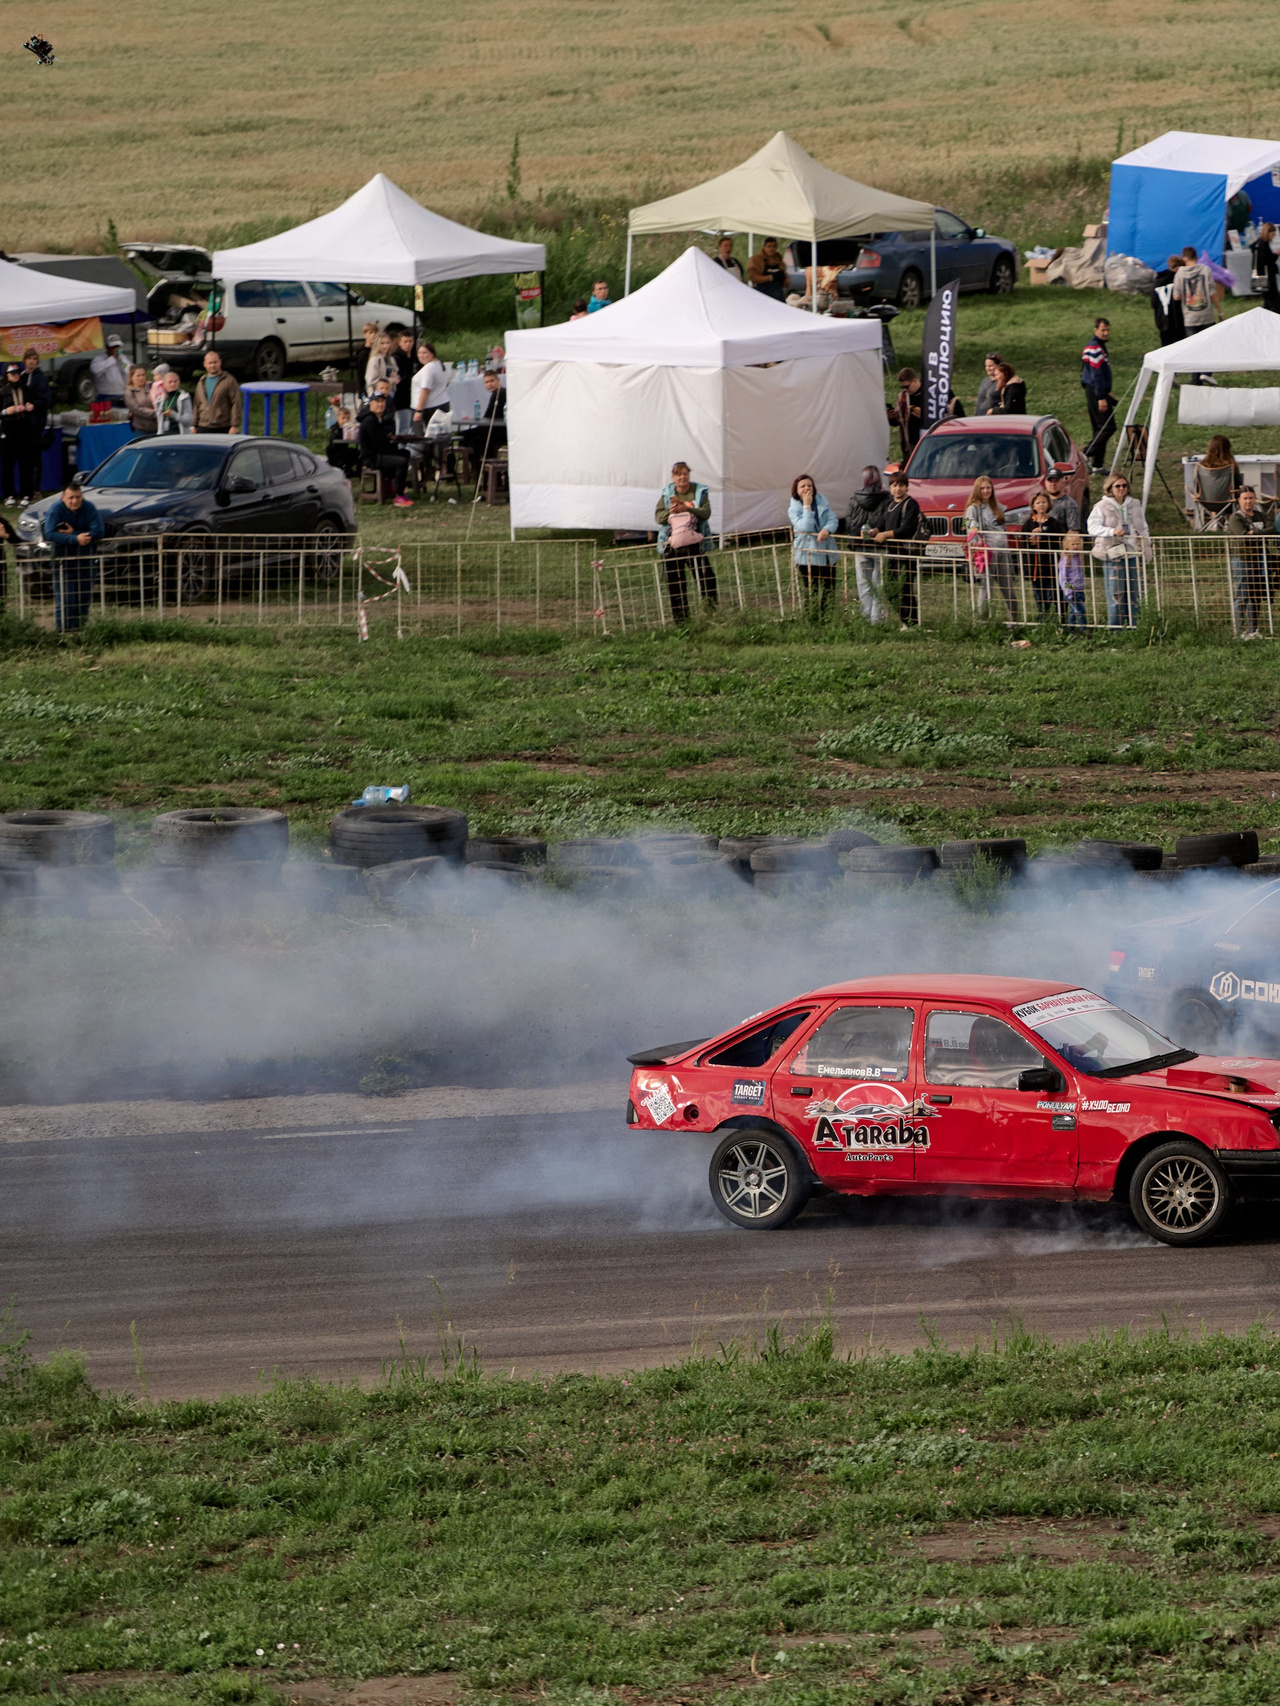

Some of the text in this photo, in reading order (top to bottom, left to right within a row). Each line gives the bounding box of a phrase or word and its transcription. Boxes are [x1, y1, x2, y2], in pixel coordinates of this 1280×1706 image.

[928, 351, 939, 419] ШАГ В
[1015, 1004, 1041, 1019] КУБОК
[817, 1064, 866, 1076] Емельянов
[734, 1084, 763, 1097] TARGET
[845, 1153, 893, 1162] AutoParts
